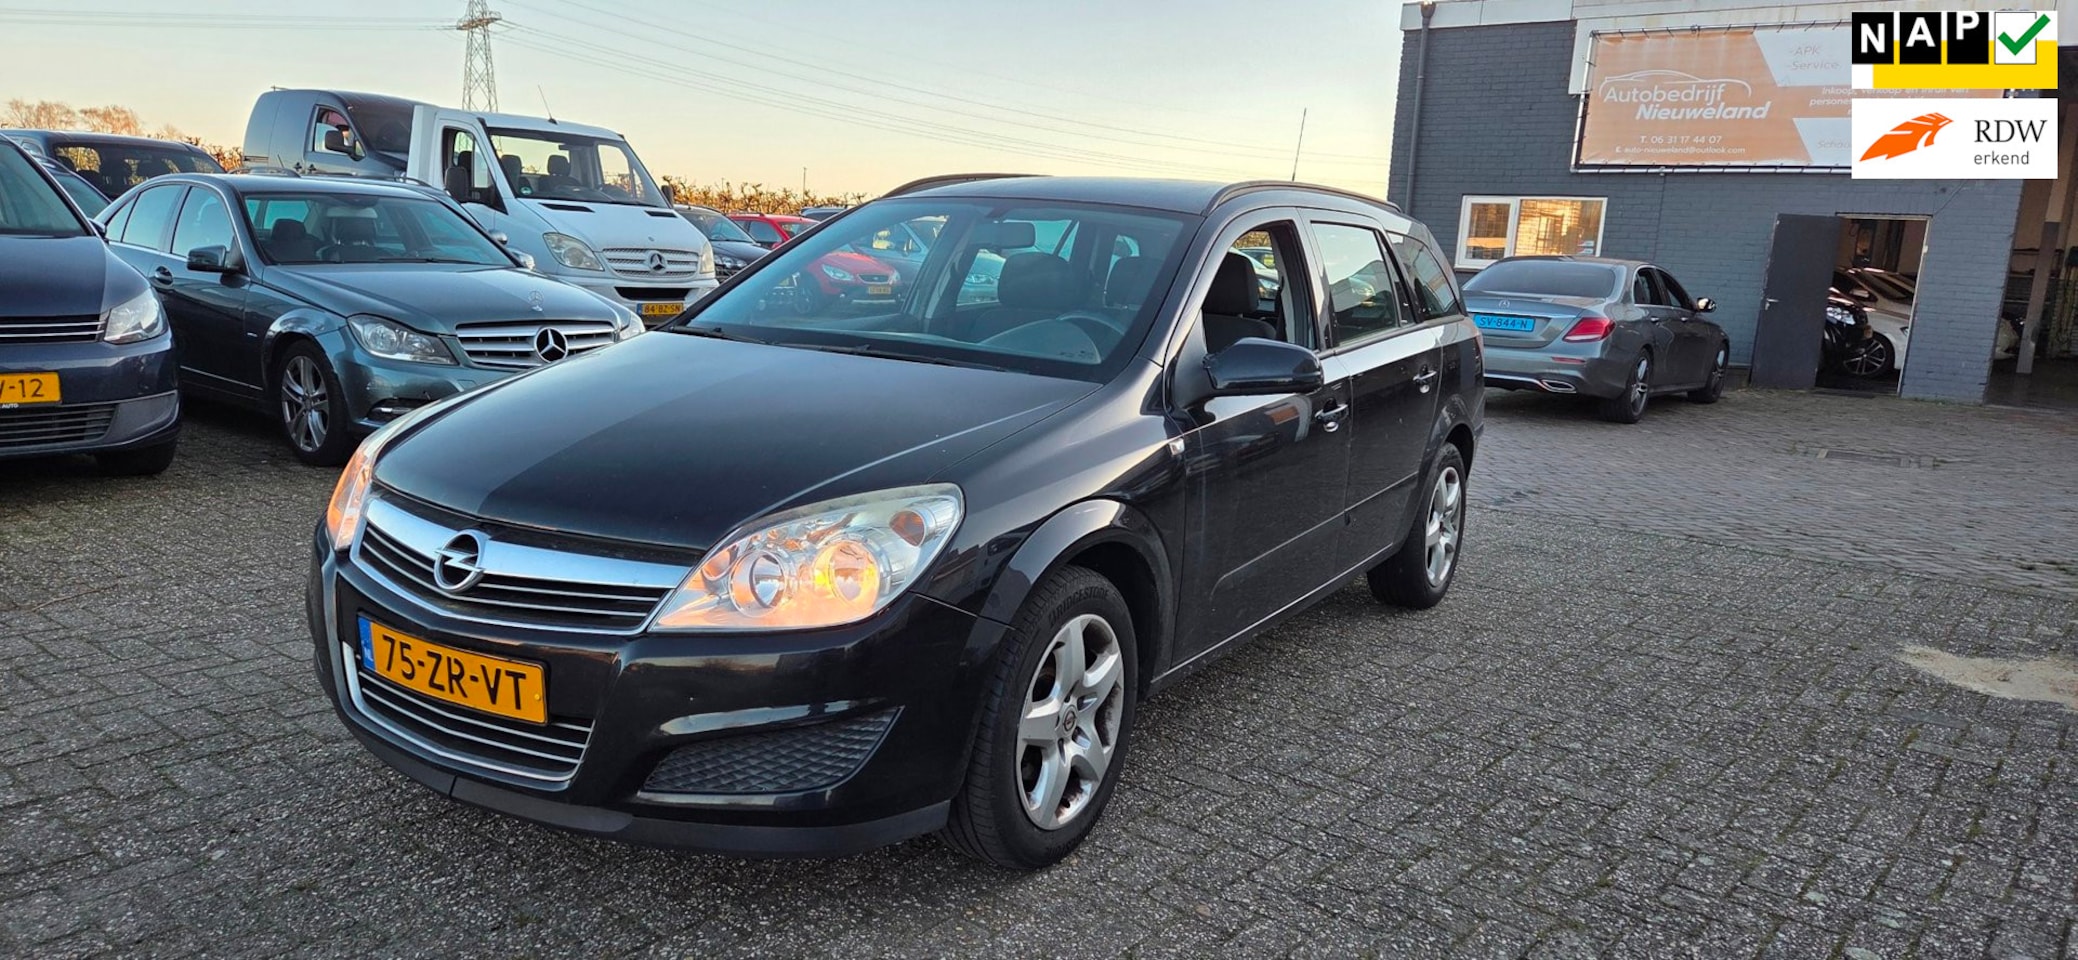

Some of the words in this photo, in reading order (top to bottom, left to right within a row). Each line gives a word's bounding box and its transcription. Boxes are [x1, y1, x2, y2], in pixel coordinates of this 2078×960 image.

[1603, 83, 1727, 106] Autobedrijf
[1635, 101, 1772, 120] Nieuweland
[1651, 136, 1664, 144] 06
[1667, 136, 1677, 144] 31
[1681, 136, 1690, 144] 17
[1693, 136, 1706, 144] 44
[1709, 135, 1723, 144] 07
[1624, 145, 1746, 154] auto-nieuweland@outlook.com
[1480, 317, 1527, 329] SV-844-N
[382, 634, 527, 710] 75-ZR-VT
